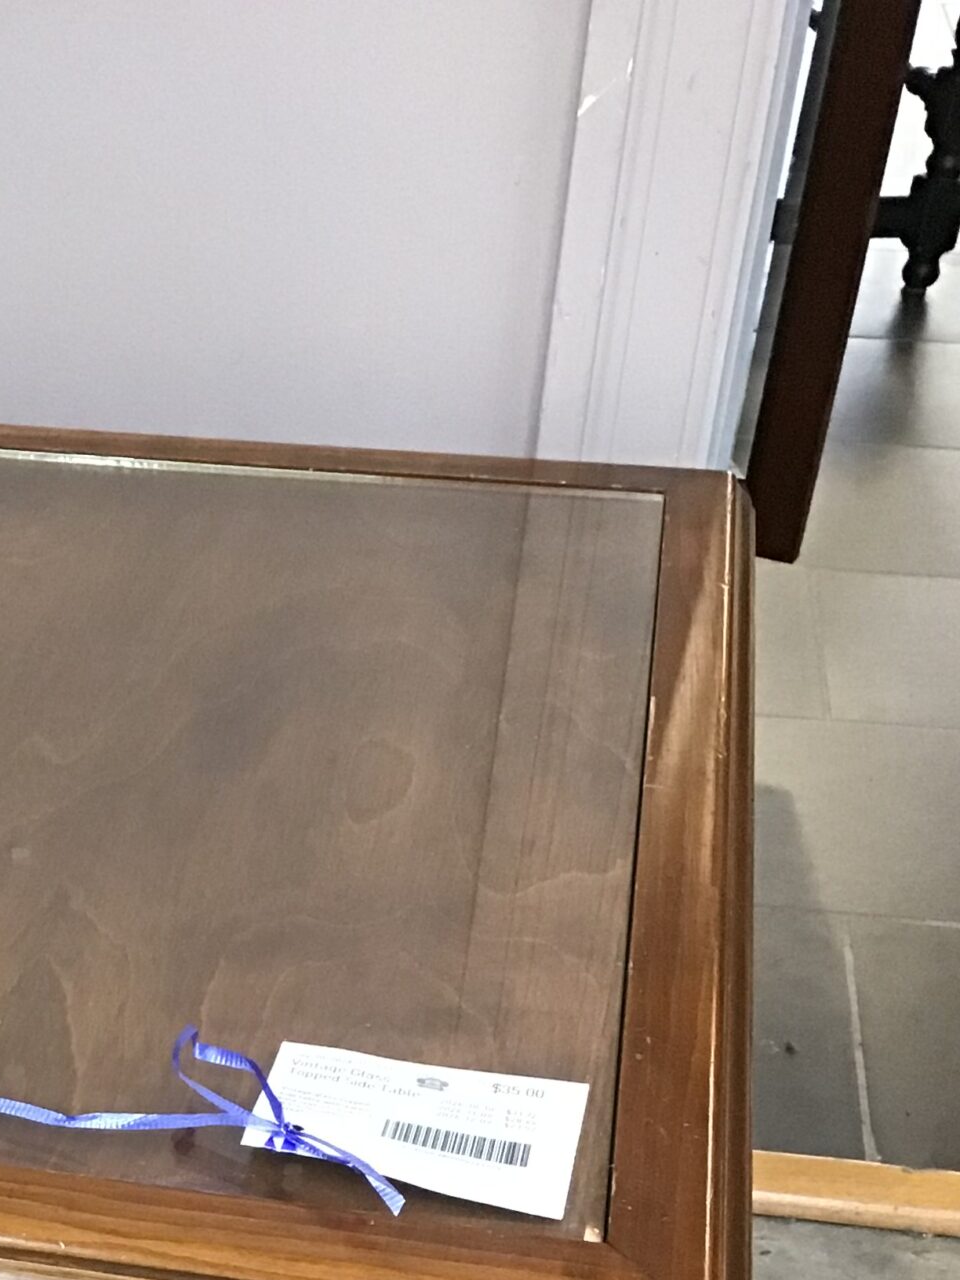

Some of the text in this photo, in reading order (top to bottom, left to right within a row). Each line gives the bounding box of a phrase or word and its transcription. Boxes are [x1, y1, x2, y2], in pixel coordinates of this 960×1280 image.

[290, 1066, 422, 1098] Topped Side Table
[292, 1058, 346, 1075] Vintage
[350, 1067, 390, 1083] Glass
[492, 1082, 545, 1098] $35.00
